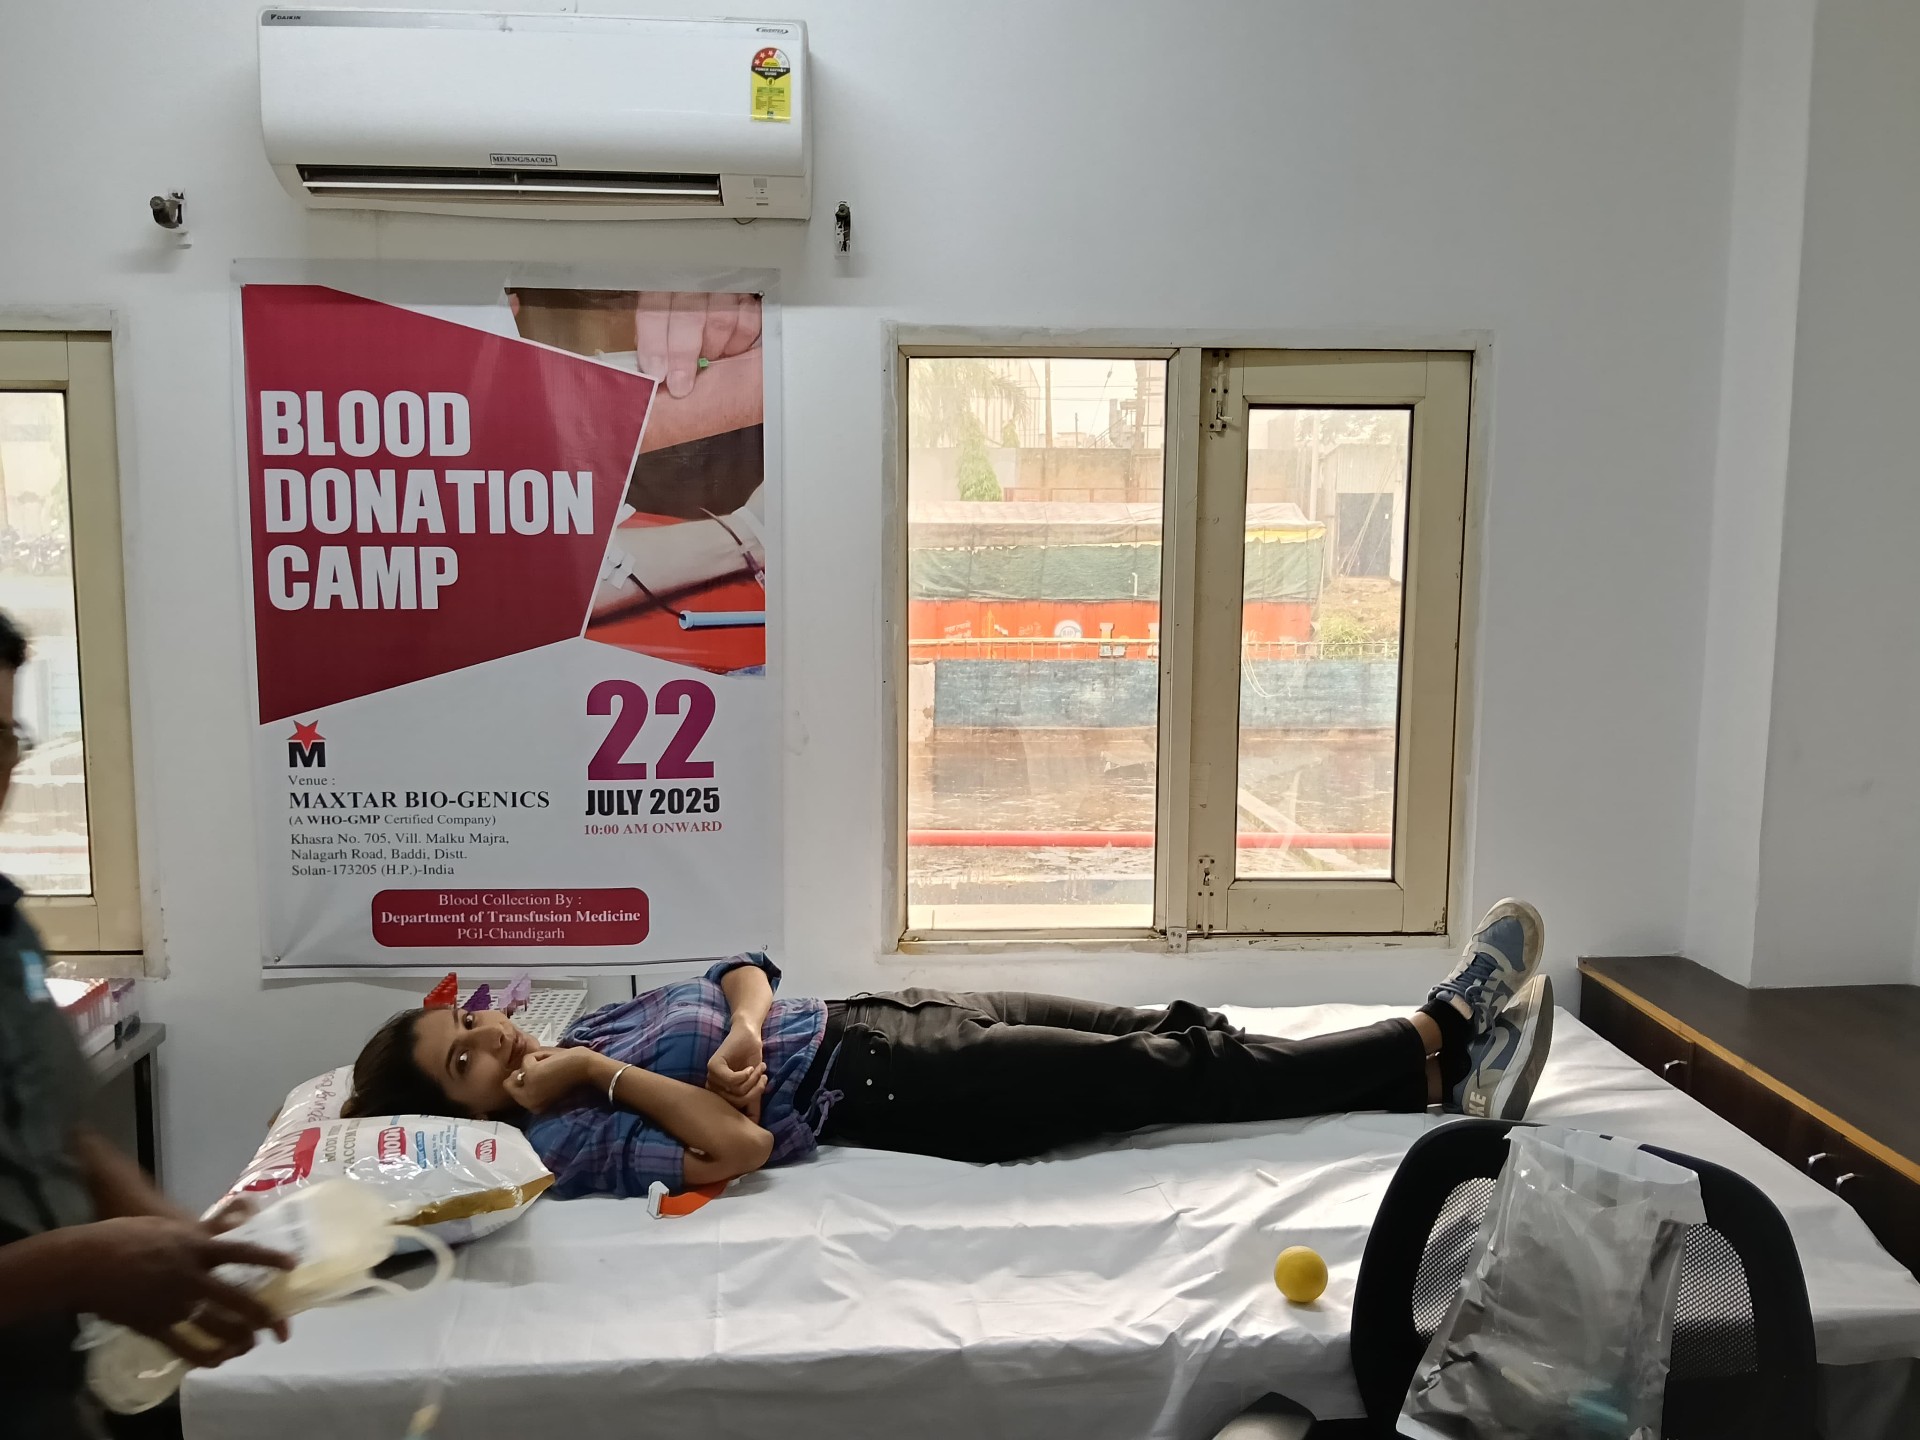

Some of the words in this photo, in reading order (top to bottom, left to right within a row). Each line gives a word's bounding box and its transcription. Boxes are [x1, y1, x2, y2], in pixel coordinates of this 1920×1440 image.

[260, 390, 471, 458] BLOOD
[263, 467, 594, 536] DONATION
[266, 544, 459, 611] CAMP
[586, 679, 716, 781] 22
[288, 775, 328, 786] Venue
[289, 791, 398, 809] MAXTAR
[404, 790, 550, 809] BIO-GENICS
[585, 789, 643, 817] JULY
[650, 787, 720, 815] 2025
[289, 816, 304, 826] (A
[307, 815, 381, 825] WHO-GMP
[384, 814, 434, 825] Certified
[437, 814, 496, 827] Company)
[584, 824, 619, 835] 10:00
[623, 823, 648, 835] AM
[652, 821, 722, 834] ONWARD
[291, 833, 334, 845] Khasra
[337, 833, 360, 845] No.
[364, 833, 391, 846] 705,
[395, 833, 422, 845] Vill.
[426, 833, 465, 845] Malku
[469, 833, 510, 847] Majra,
[291, 849, 347, 863] Nalagarh
[351, 849, 387, 861] Road,
[391, 849, 430, 861] Baddi,
[434, 849, 467, 860] Distt.
[291, 864, 377, 876] Solan-173205
[381, 863, 455, 877] (H.P.)-India
[439, 893, 478, 906] Blood
[482, 893, 551, 906] Collection
[555, 894, 573, 908] By
[381, 911, 465, 926] Department
[469, 911, 484, 923] of
[486, 911, 572, 923] Transfusion
[575, 910, 641, 923] Medicine
[457, 927, 565, 942] PGI-Chandigarh
